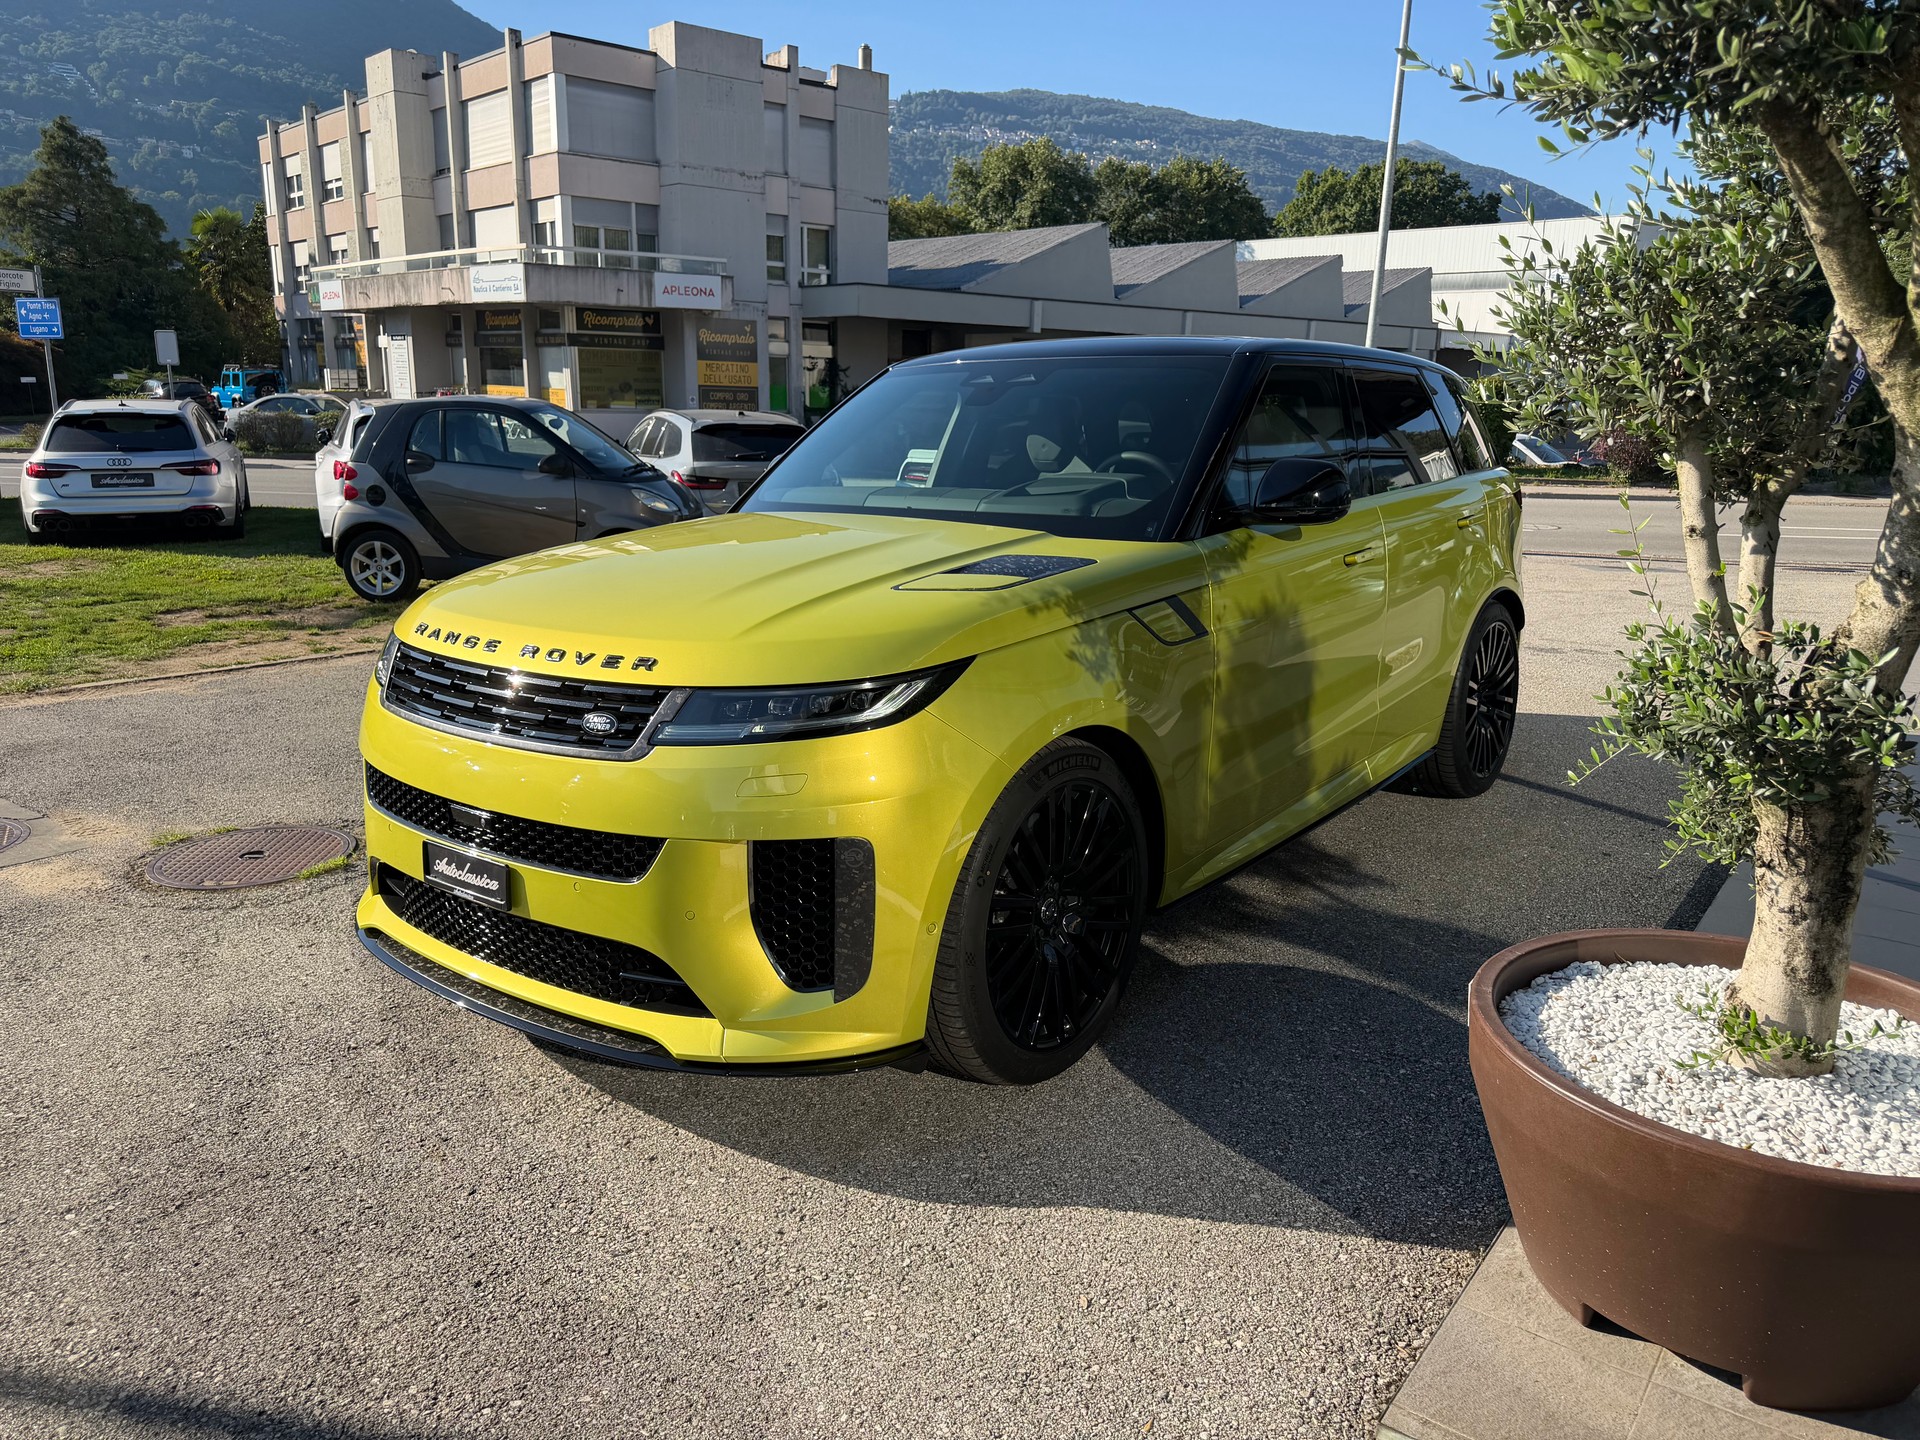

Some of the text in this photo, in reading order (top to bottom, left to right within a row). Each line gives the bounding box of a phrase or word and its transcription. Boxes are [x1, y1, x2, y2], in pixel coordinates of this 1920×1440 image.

[0, 271, 24, 280] orcote
[473, 285, 488, 293] Nautica
[662, 285, 715, 298] APLEONA
[322, 291, 341, 300] APLEONA
[26, 302, 56, 310] Ponte Tresa
[28, 312, 43, 321] Agno
[29, 325, 49, 334] Lugano
[594, 337, 650, 346] VINTAGE SHOP
[705, 348, 732, 356] VINTAGE
[705, 363, 750, 374] MERCATINO
[703, 373, 752, 385] DELL'USATO
[709, 392, 749, 401] COMPRO ORO
[703, 402, 756, 411] COMPRO ARGENTO
[413, 621, 660, 673] RANGE ROVER
[588, 715, 607, 723] LAND
[588, 722, 611, 731] ROVER
[1047, 754, 1100, 777] MICHELIN
[433, 856, 500, 891] Autoclassica
